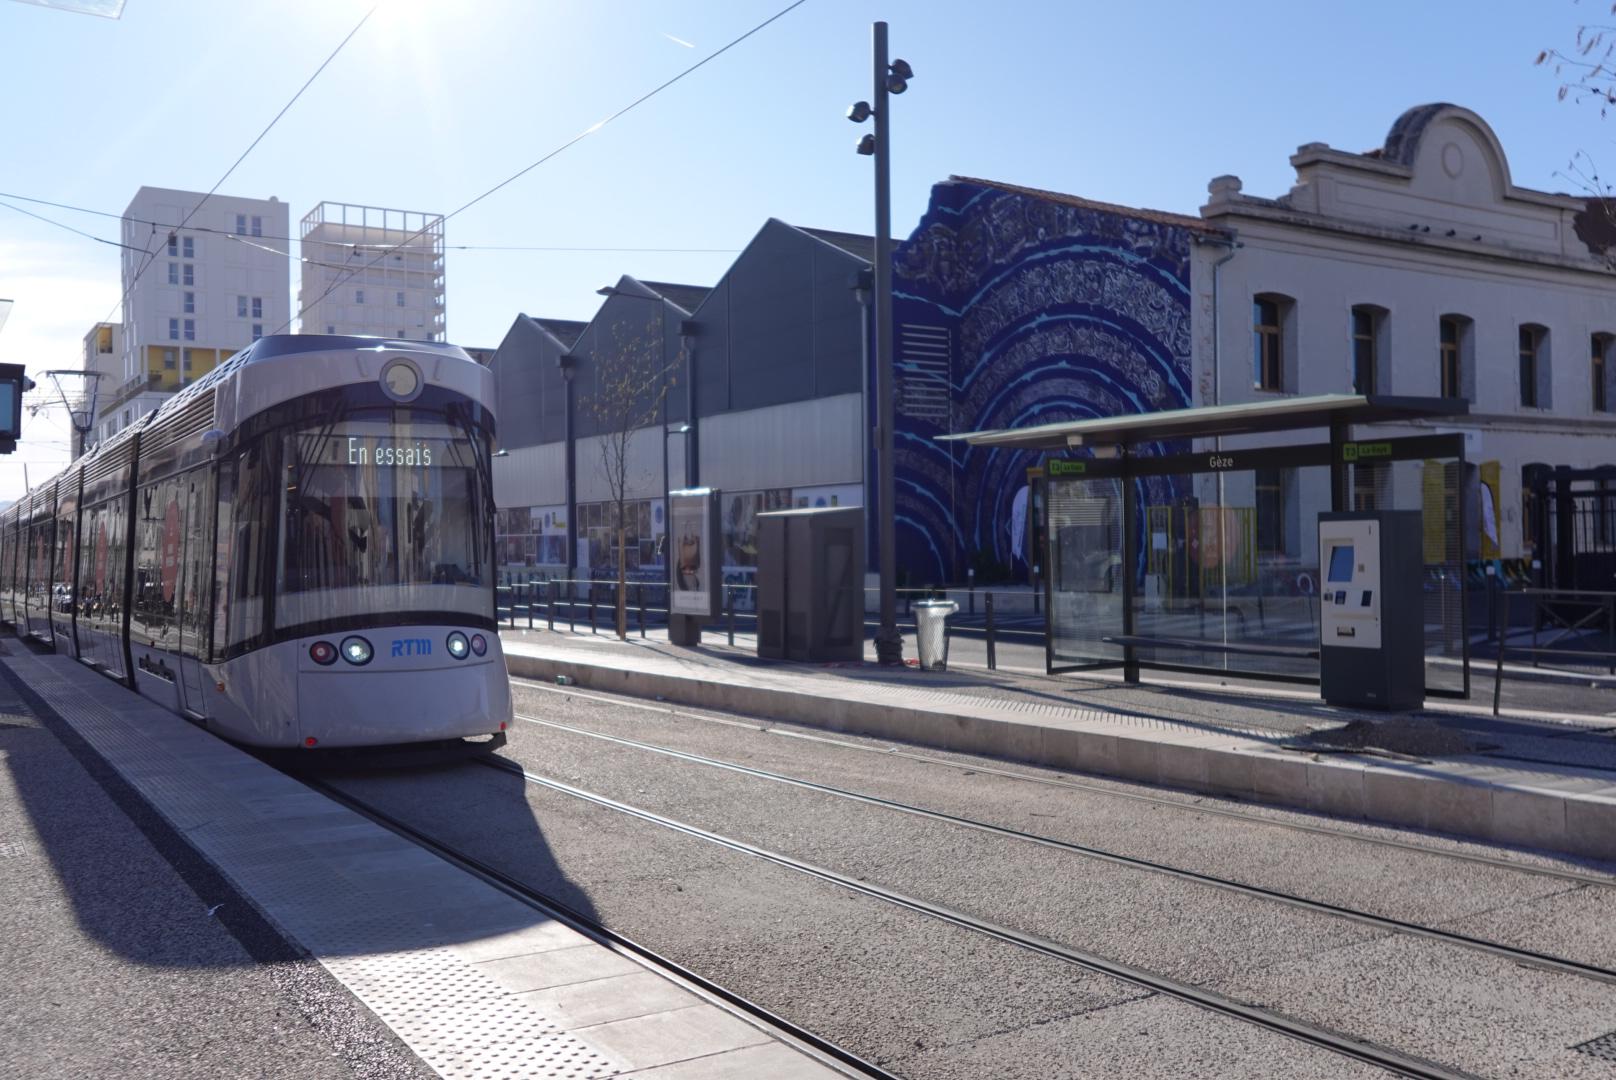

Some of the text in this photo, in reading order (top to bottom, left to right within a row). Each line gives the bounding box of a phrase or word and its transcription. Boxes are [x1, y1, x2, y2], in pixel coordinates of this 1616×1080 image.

[348, 437, 431, 466] En essais
[1209, 455, 1233, 468] Gèze
[391, 639, 432, 657] RTM
